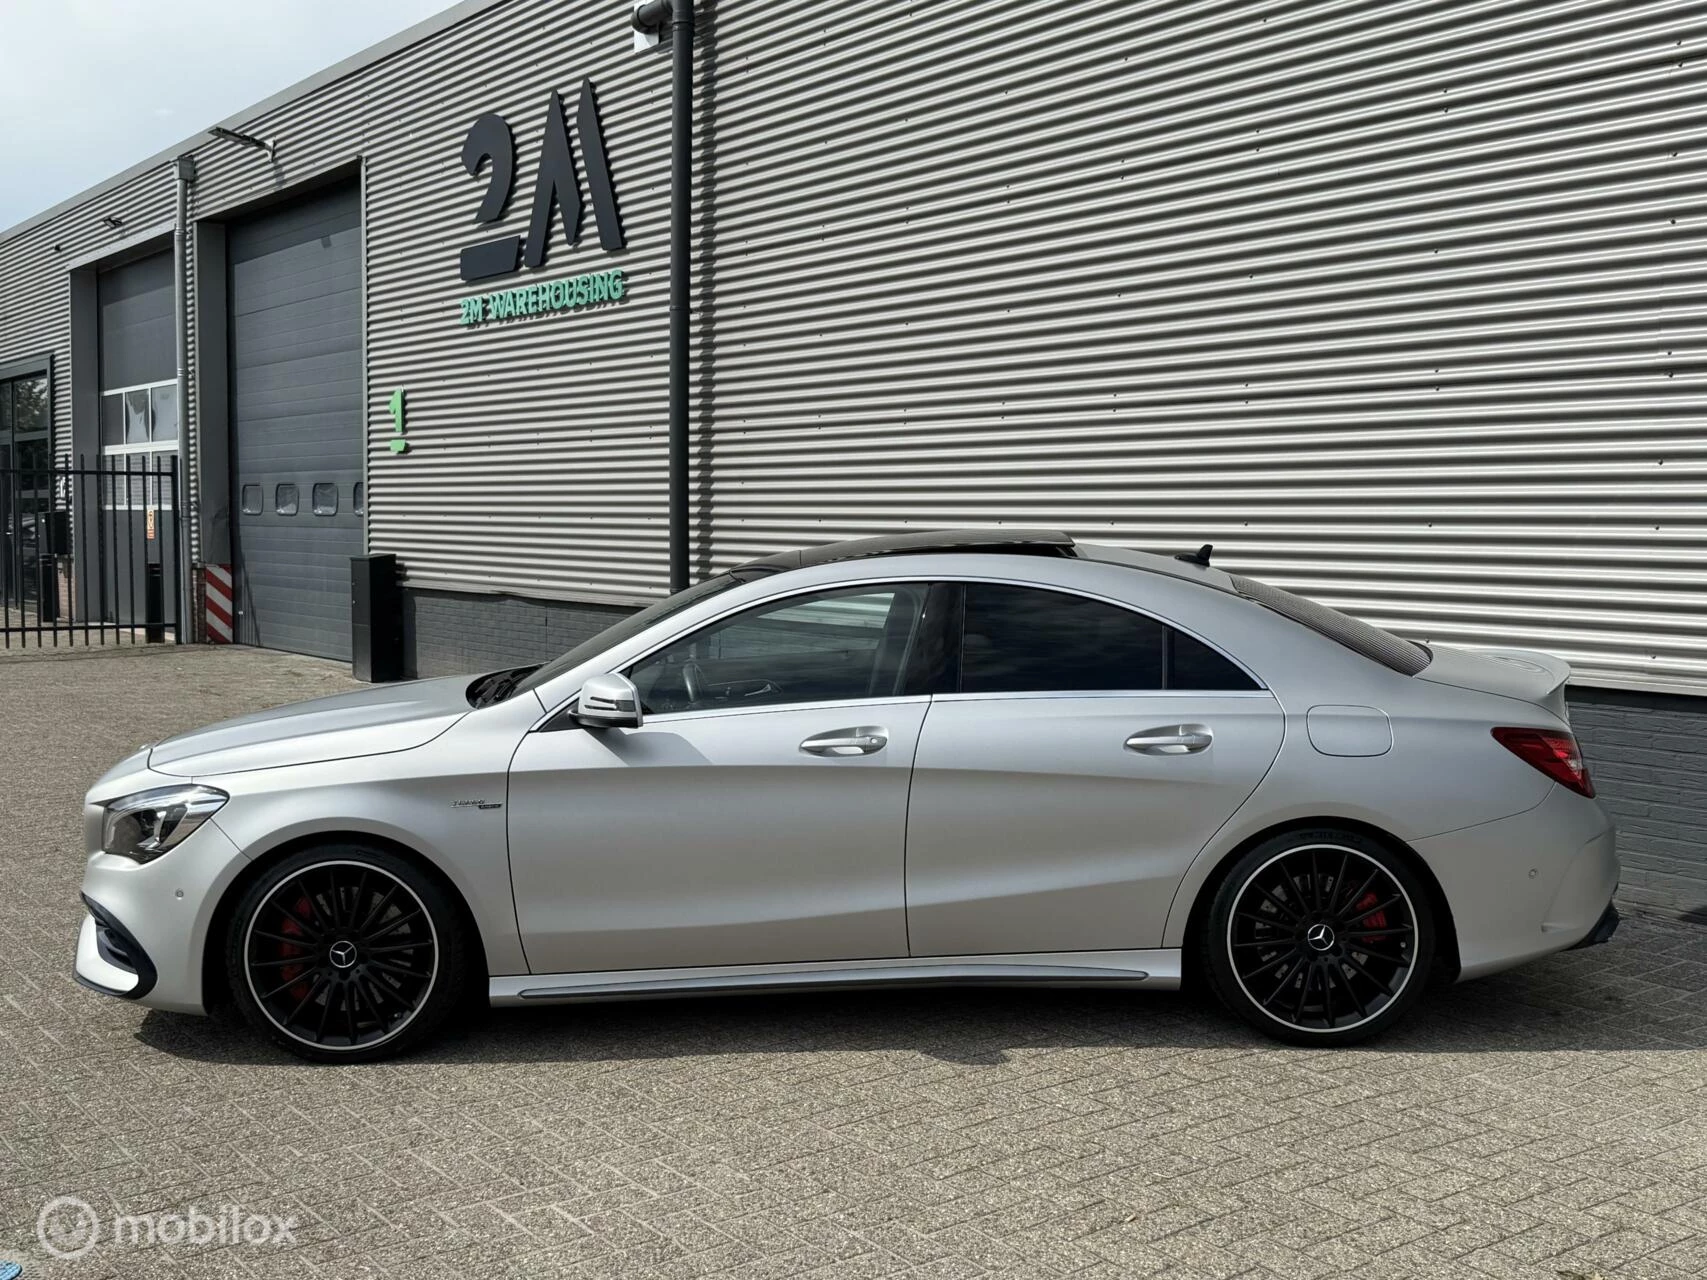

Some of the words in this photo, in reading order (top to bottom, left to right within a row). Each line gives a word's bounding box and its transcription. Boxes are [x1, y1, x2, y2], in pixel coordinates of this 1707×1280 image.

[460, 74, 624, 281] 2M
[460, 297, 483, 325] 2M
[487, 269, 625, 319] WAREHOUSING
